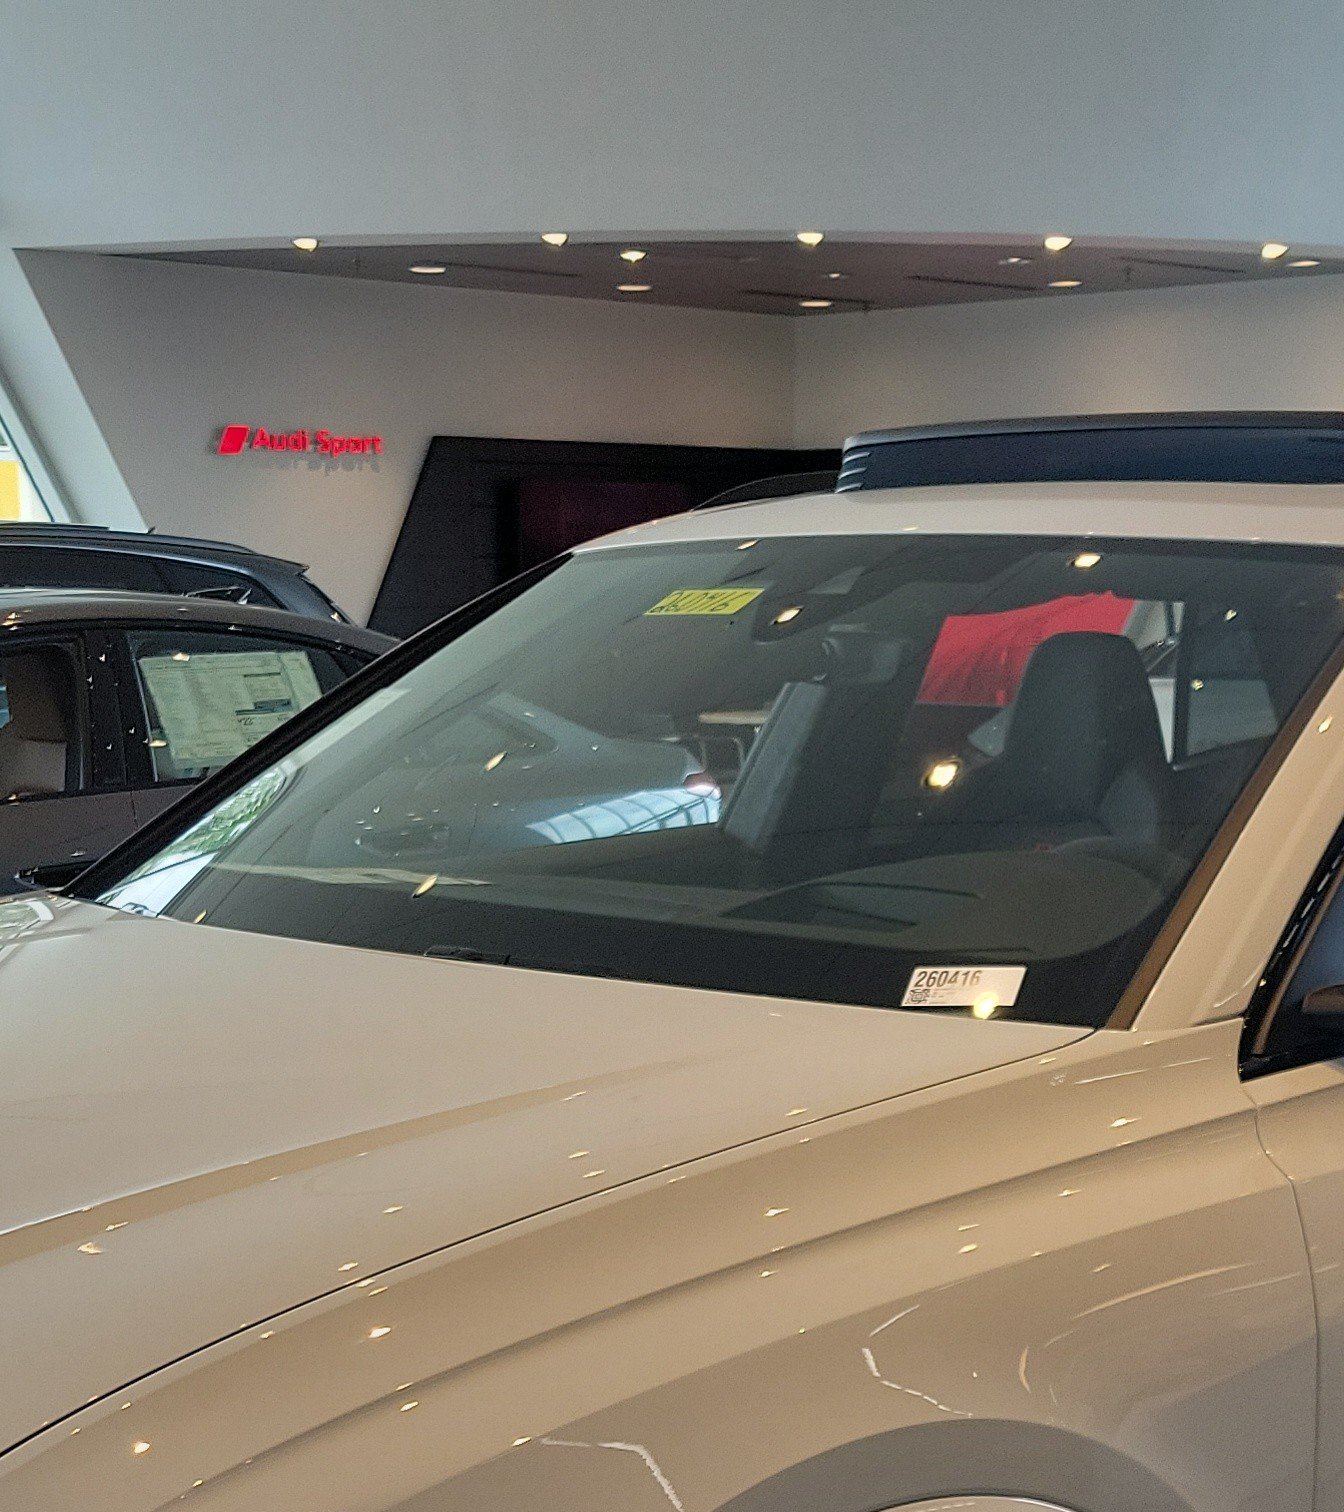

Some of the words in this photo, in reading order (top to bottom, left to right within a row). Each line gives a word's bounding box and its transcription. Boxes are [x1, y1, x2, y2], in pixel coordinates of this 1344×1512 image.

[253, 427, 309, 451] Audi
[317, 429, 383, 457] Sport
[914, 970, 982, 988] 260416
